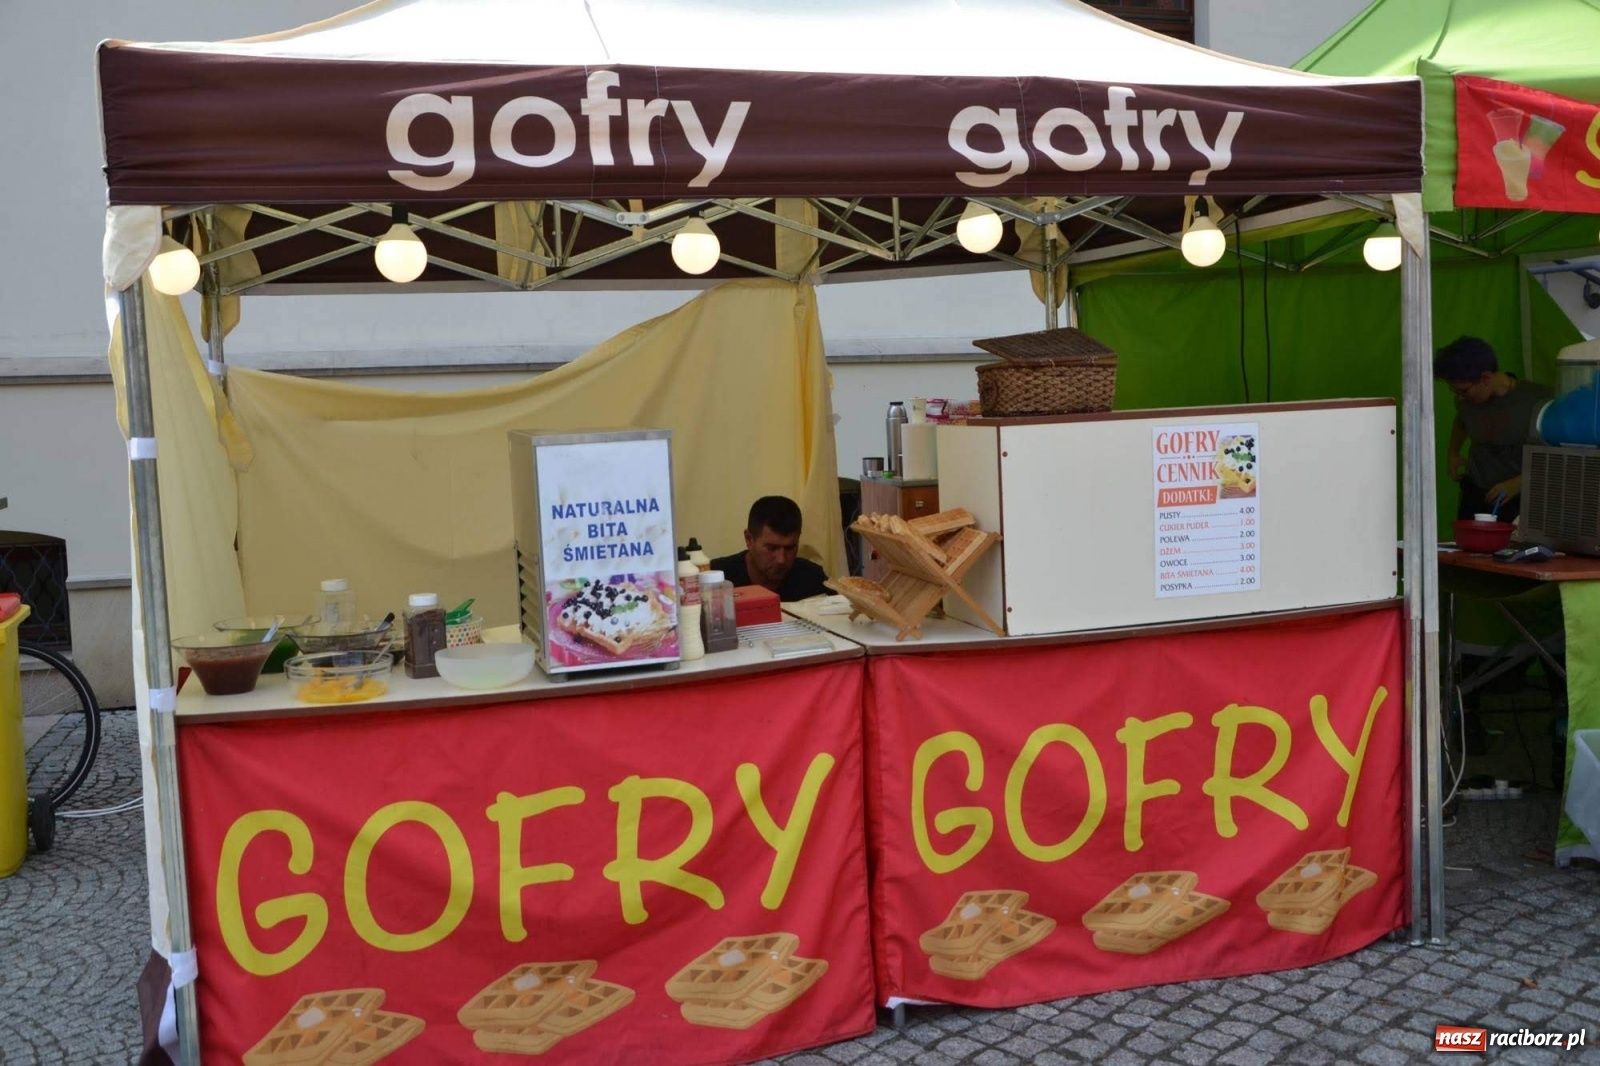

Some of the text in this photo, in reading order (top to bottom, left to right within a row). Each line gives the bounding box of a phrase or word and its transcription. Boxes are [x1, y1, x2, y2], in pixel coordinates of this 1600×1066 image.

[385, 70, 752, 192] gofry
[947, 85, 1245, 188] gofry
[1156, 430, 1220, 455] GOFRY
[1156, 461, 1220, 483] CENNIK
[1162, 489, 1213, 504] DODATKI:
[551, 497, 660, 520] NATURALNA
[1159, 506, 1255, 520] PUSTY 4.00
[587, 521, 628, 539] BITA
[1159, 518, 1255, 532] CUKIER PUDER 1.00
[1159, 530, 1255, 544] POLEWA 2.00
[563, 541, 654, 562] ŚMIETANA
[1160, 559, 1188, 567] OWOCE
[1160, 572, 1175, 580] BITA
[1240, 565, 1255, 573] 4.00
[1160, 577, 1256, 592] POSYPKA 2.00
[911, 686, 1388, 874] GOFRY
[216, 753, 835, 976] GOFRY
